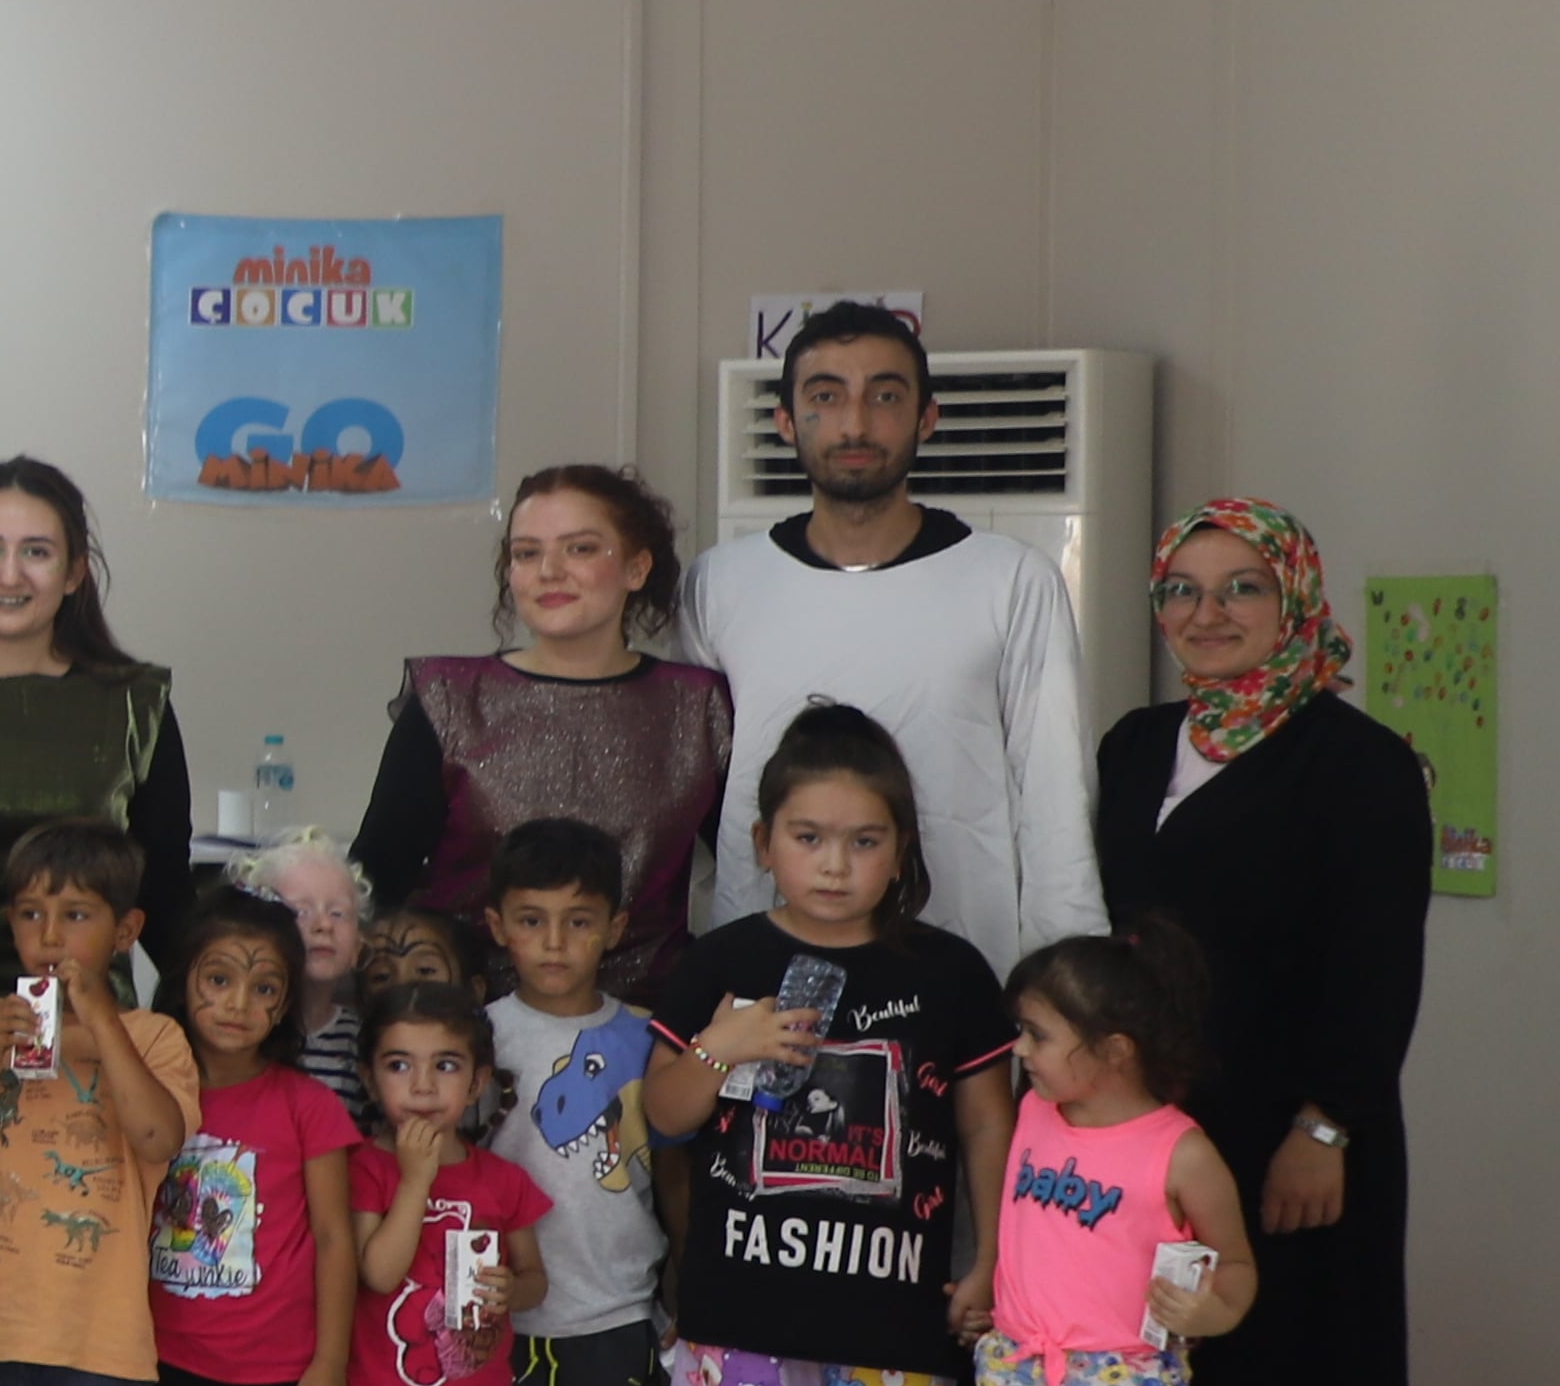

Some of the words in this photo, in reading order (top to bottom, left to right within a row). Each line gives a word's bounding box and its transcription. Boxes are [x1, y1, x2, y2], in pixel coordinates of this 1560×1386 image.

[233, 244, 371, 285] minika
[196, 290, 408, 325] ÇOCUK
[195, 397, 404, 469] GO
[848, 995, 921, 1030] Beautiful
[770, 1138, 880, 1170] NORMAL
[848, 1125, 884, 1146] IT'S
[1013, 1148, 1124, 1232] baby
[724, 1209, 923, 1284] FASHION
[154, 1247, 182, 1278] Tea
[183, 1265, 248, 1291] junkie
